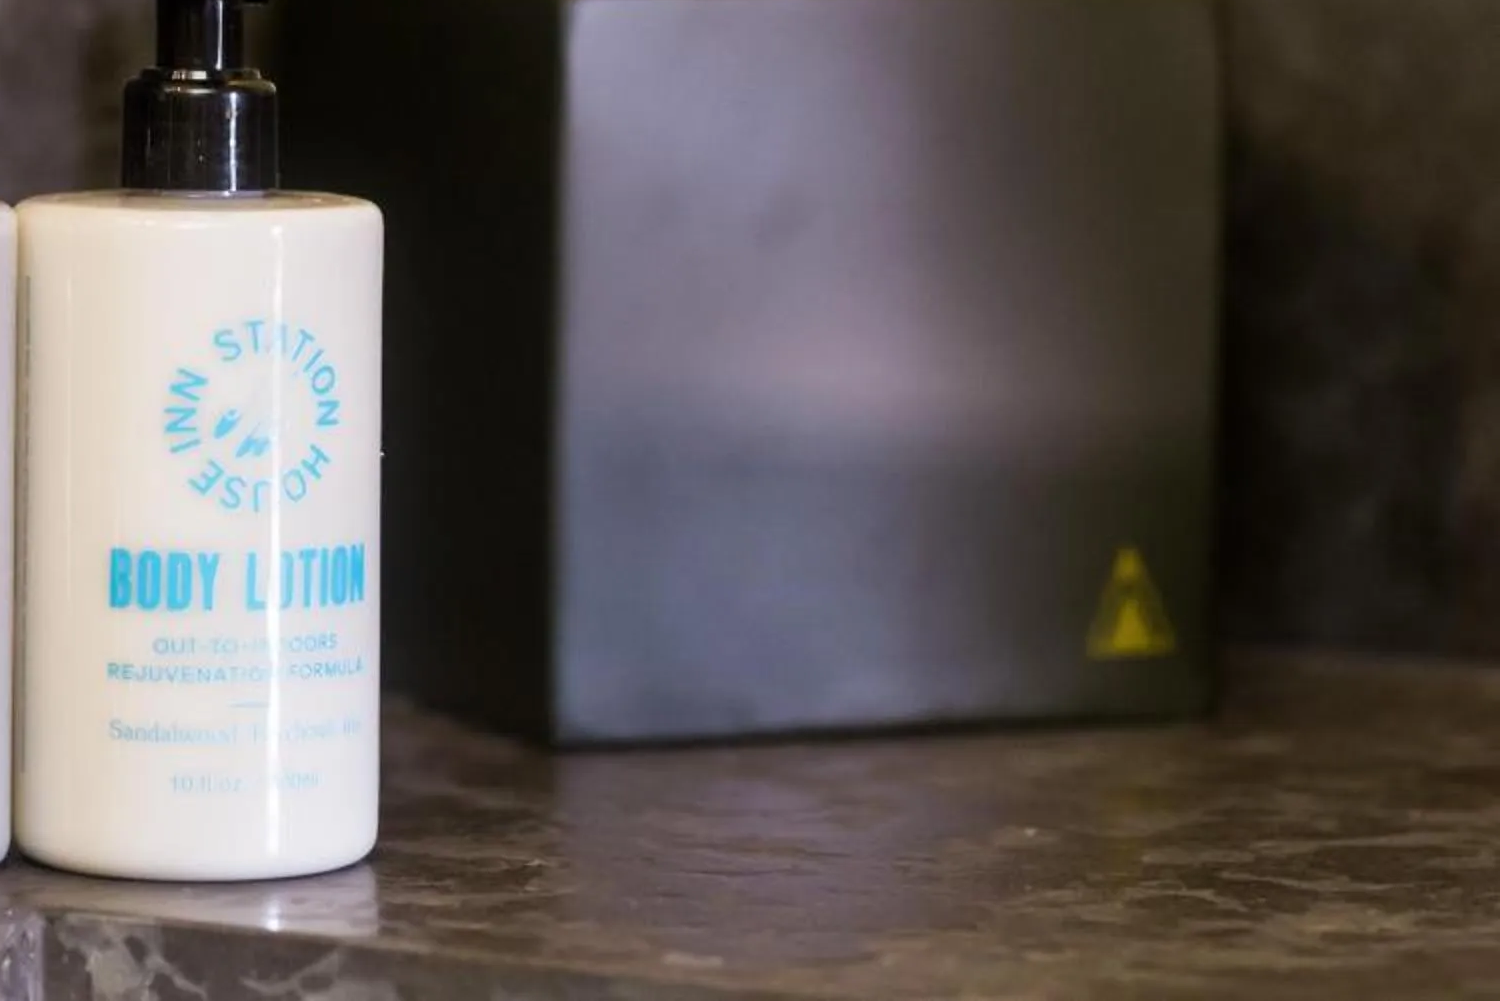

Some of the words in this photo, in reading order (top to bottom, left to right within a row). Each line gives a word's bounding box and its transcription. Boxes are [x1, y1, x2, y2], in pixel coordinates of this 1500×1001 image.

[164, 368, 208, 453] INN
[108, 546, 220, 611] BODY
[245, 543, 365, 612] LOTION
[107, 663, 277, 683] REJUVENATIO
[288, 657, 364, 680] FORMULA
